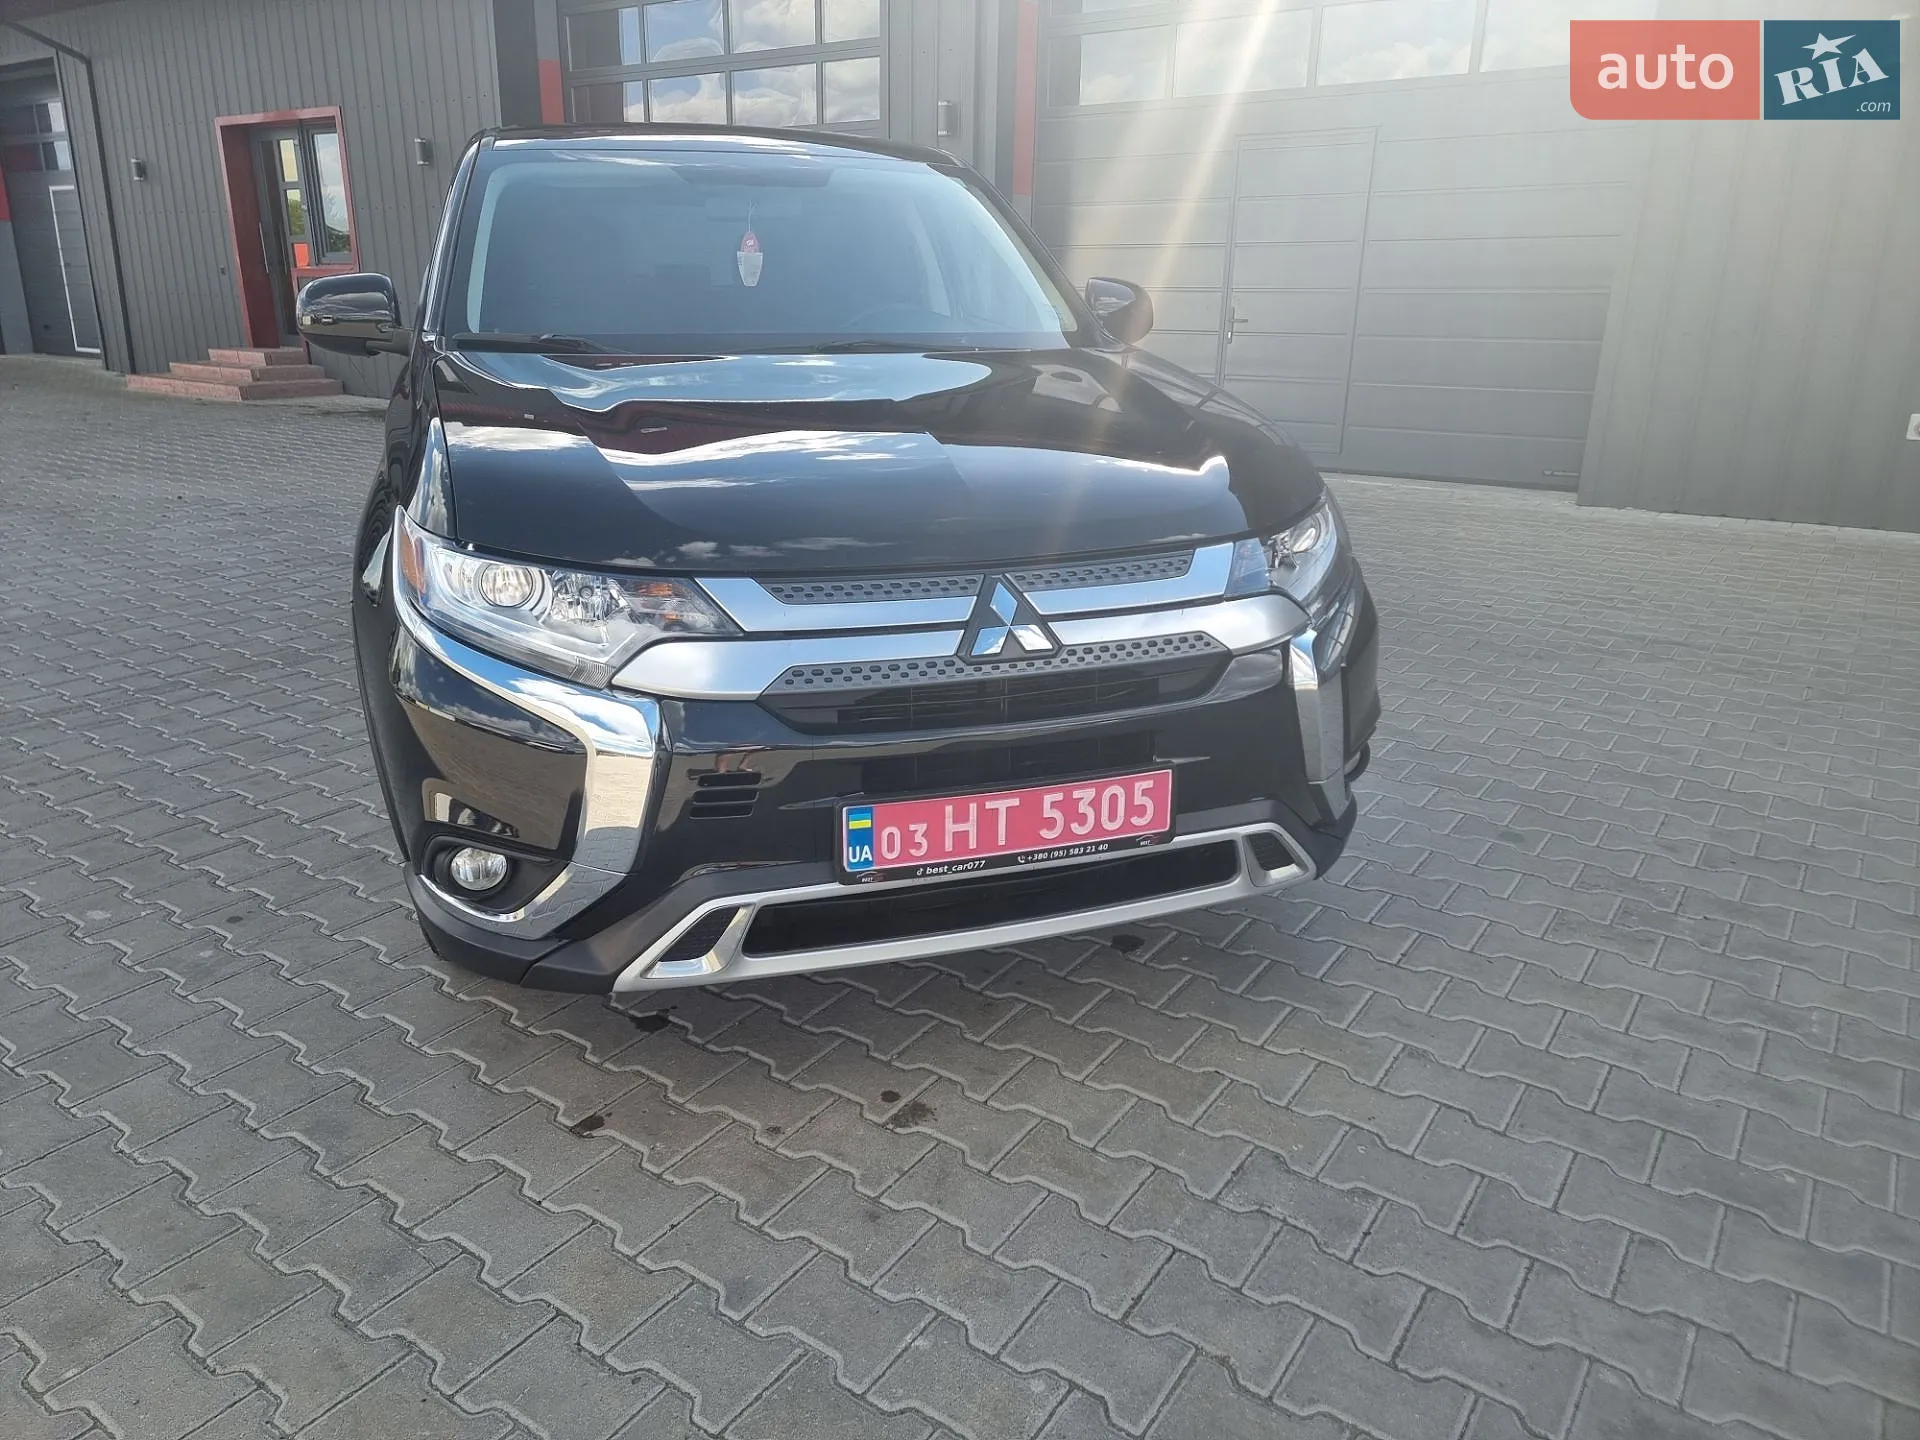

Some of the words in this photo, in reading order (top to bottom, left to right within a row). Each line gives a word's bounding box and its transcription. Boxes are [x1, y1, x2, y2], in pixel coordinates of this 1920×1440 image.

[881, 823, 928, 860] 03
[944, 799, 1020, 852] HT
[1039, 780, 1154, 839] 5305
[849, 845, 873, 863] UA
[1027, 852, 1048, 862] +380
[925, 860, 986, 875] best_car077
